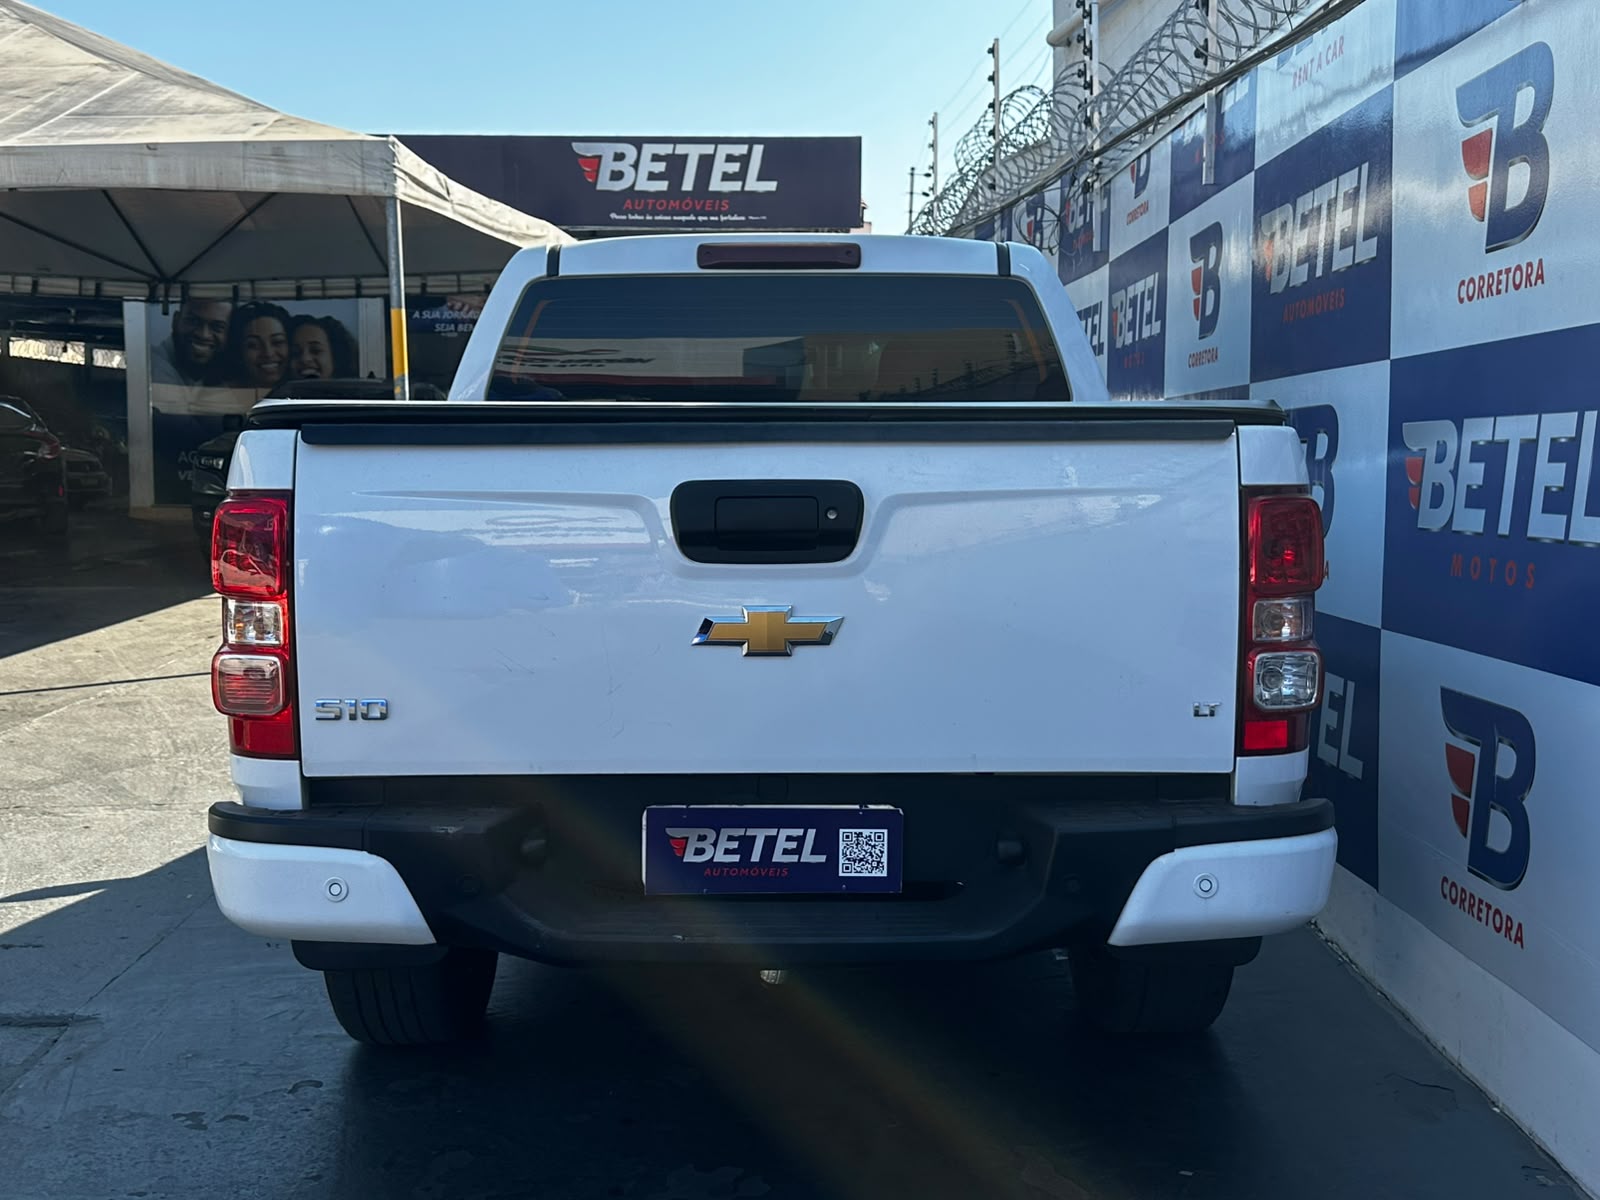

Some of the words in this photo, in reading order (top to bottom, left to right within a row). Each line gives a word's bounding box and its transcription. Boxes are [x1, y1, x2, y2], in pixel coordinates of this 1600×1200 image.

[1325, 35, 1345, 66] CAR
[571, 142, 778, 192] BETEL
[623, 197, 730, 211] AUTOMÓVEIS
[1261, 162, 1378, 294] BETEL
[1457, 258, 1545, 304] CORRETORA
[442, 310, 480, 319] JORNAD
[1111, 272, 1162, 348] BETEL
[1076, 300, 1105, 357] TEL
[1402, 410, 1600, 548] BETEL
[1451, 554, 1536, 589] MOTOS
[314, 698, 389, 721] S10
[1193, 701, 1222, 717] LT
[665, 828, 827, 864] BETEL
[704, 867, 788, 878] AUTOMÓVEIS
[1440, 876, 1524, 949] CORRETORA
